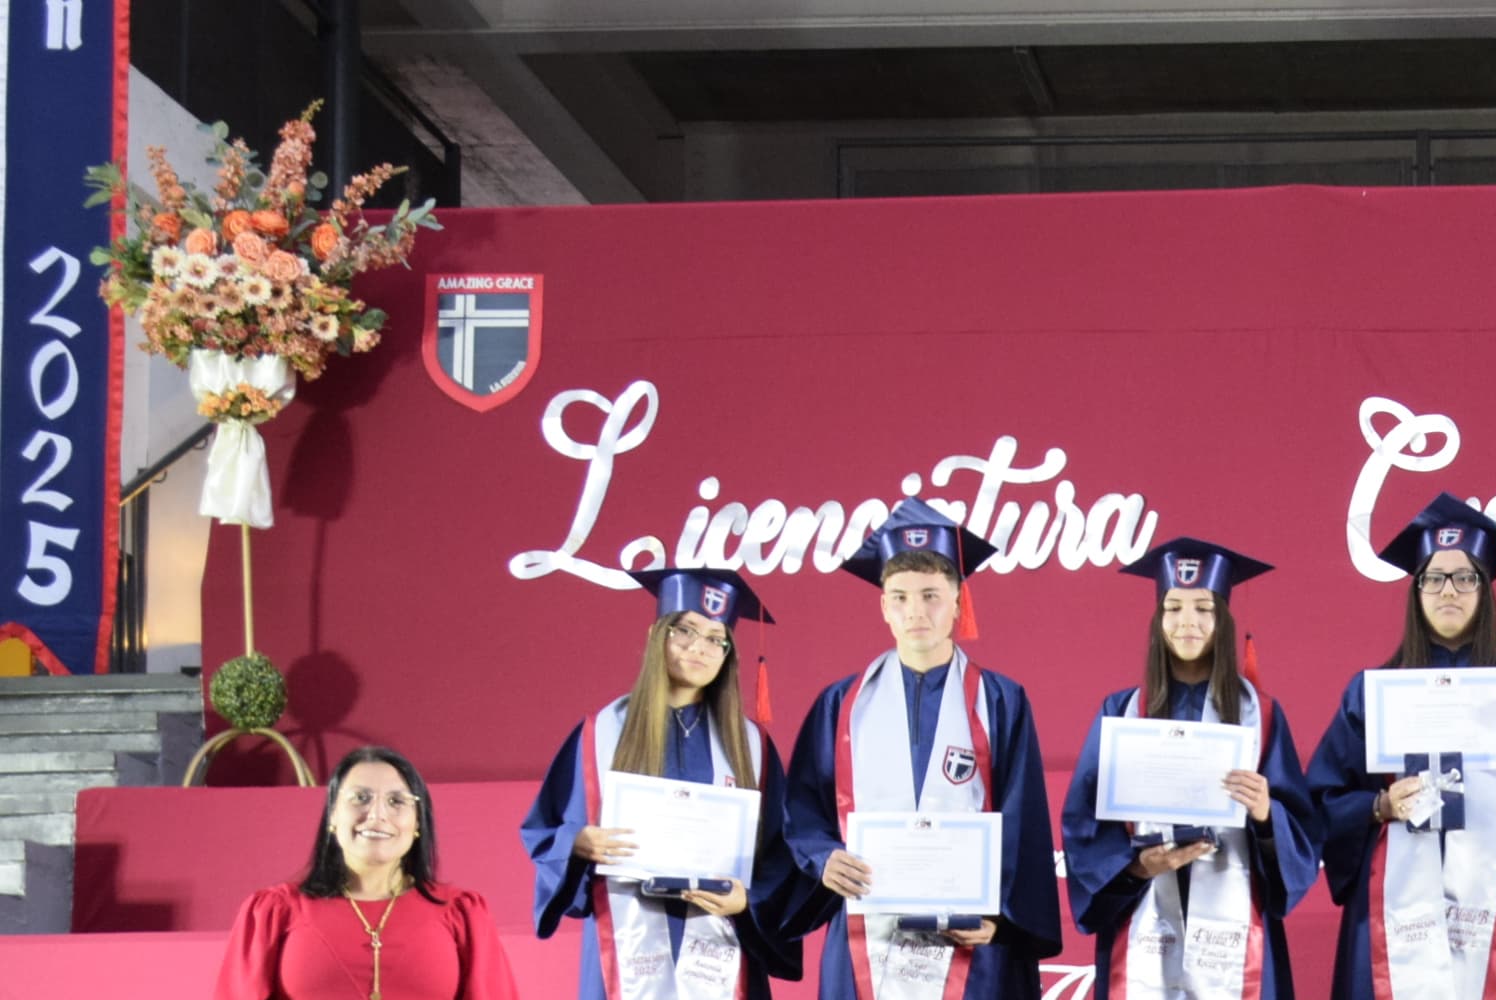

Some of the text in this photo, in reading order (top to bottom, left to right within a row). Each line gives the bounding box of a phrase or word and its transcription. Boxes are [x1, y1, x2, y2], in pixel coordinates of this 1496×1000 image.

[437, 277, 535, 289] AMAZING GRACE
[17, 246, 82, 607] 2025
[509, 380, 1158, 590] Licenctura
